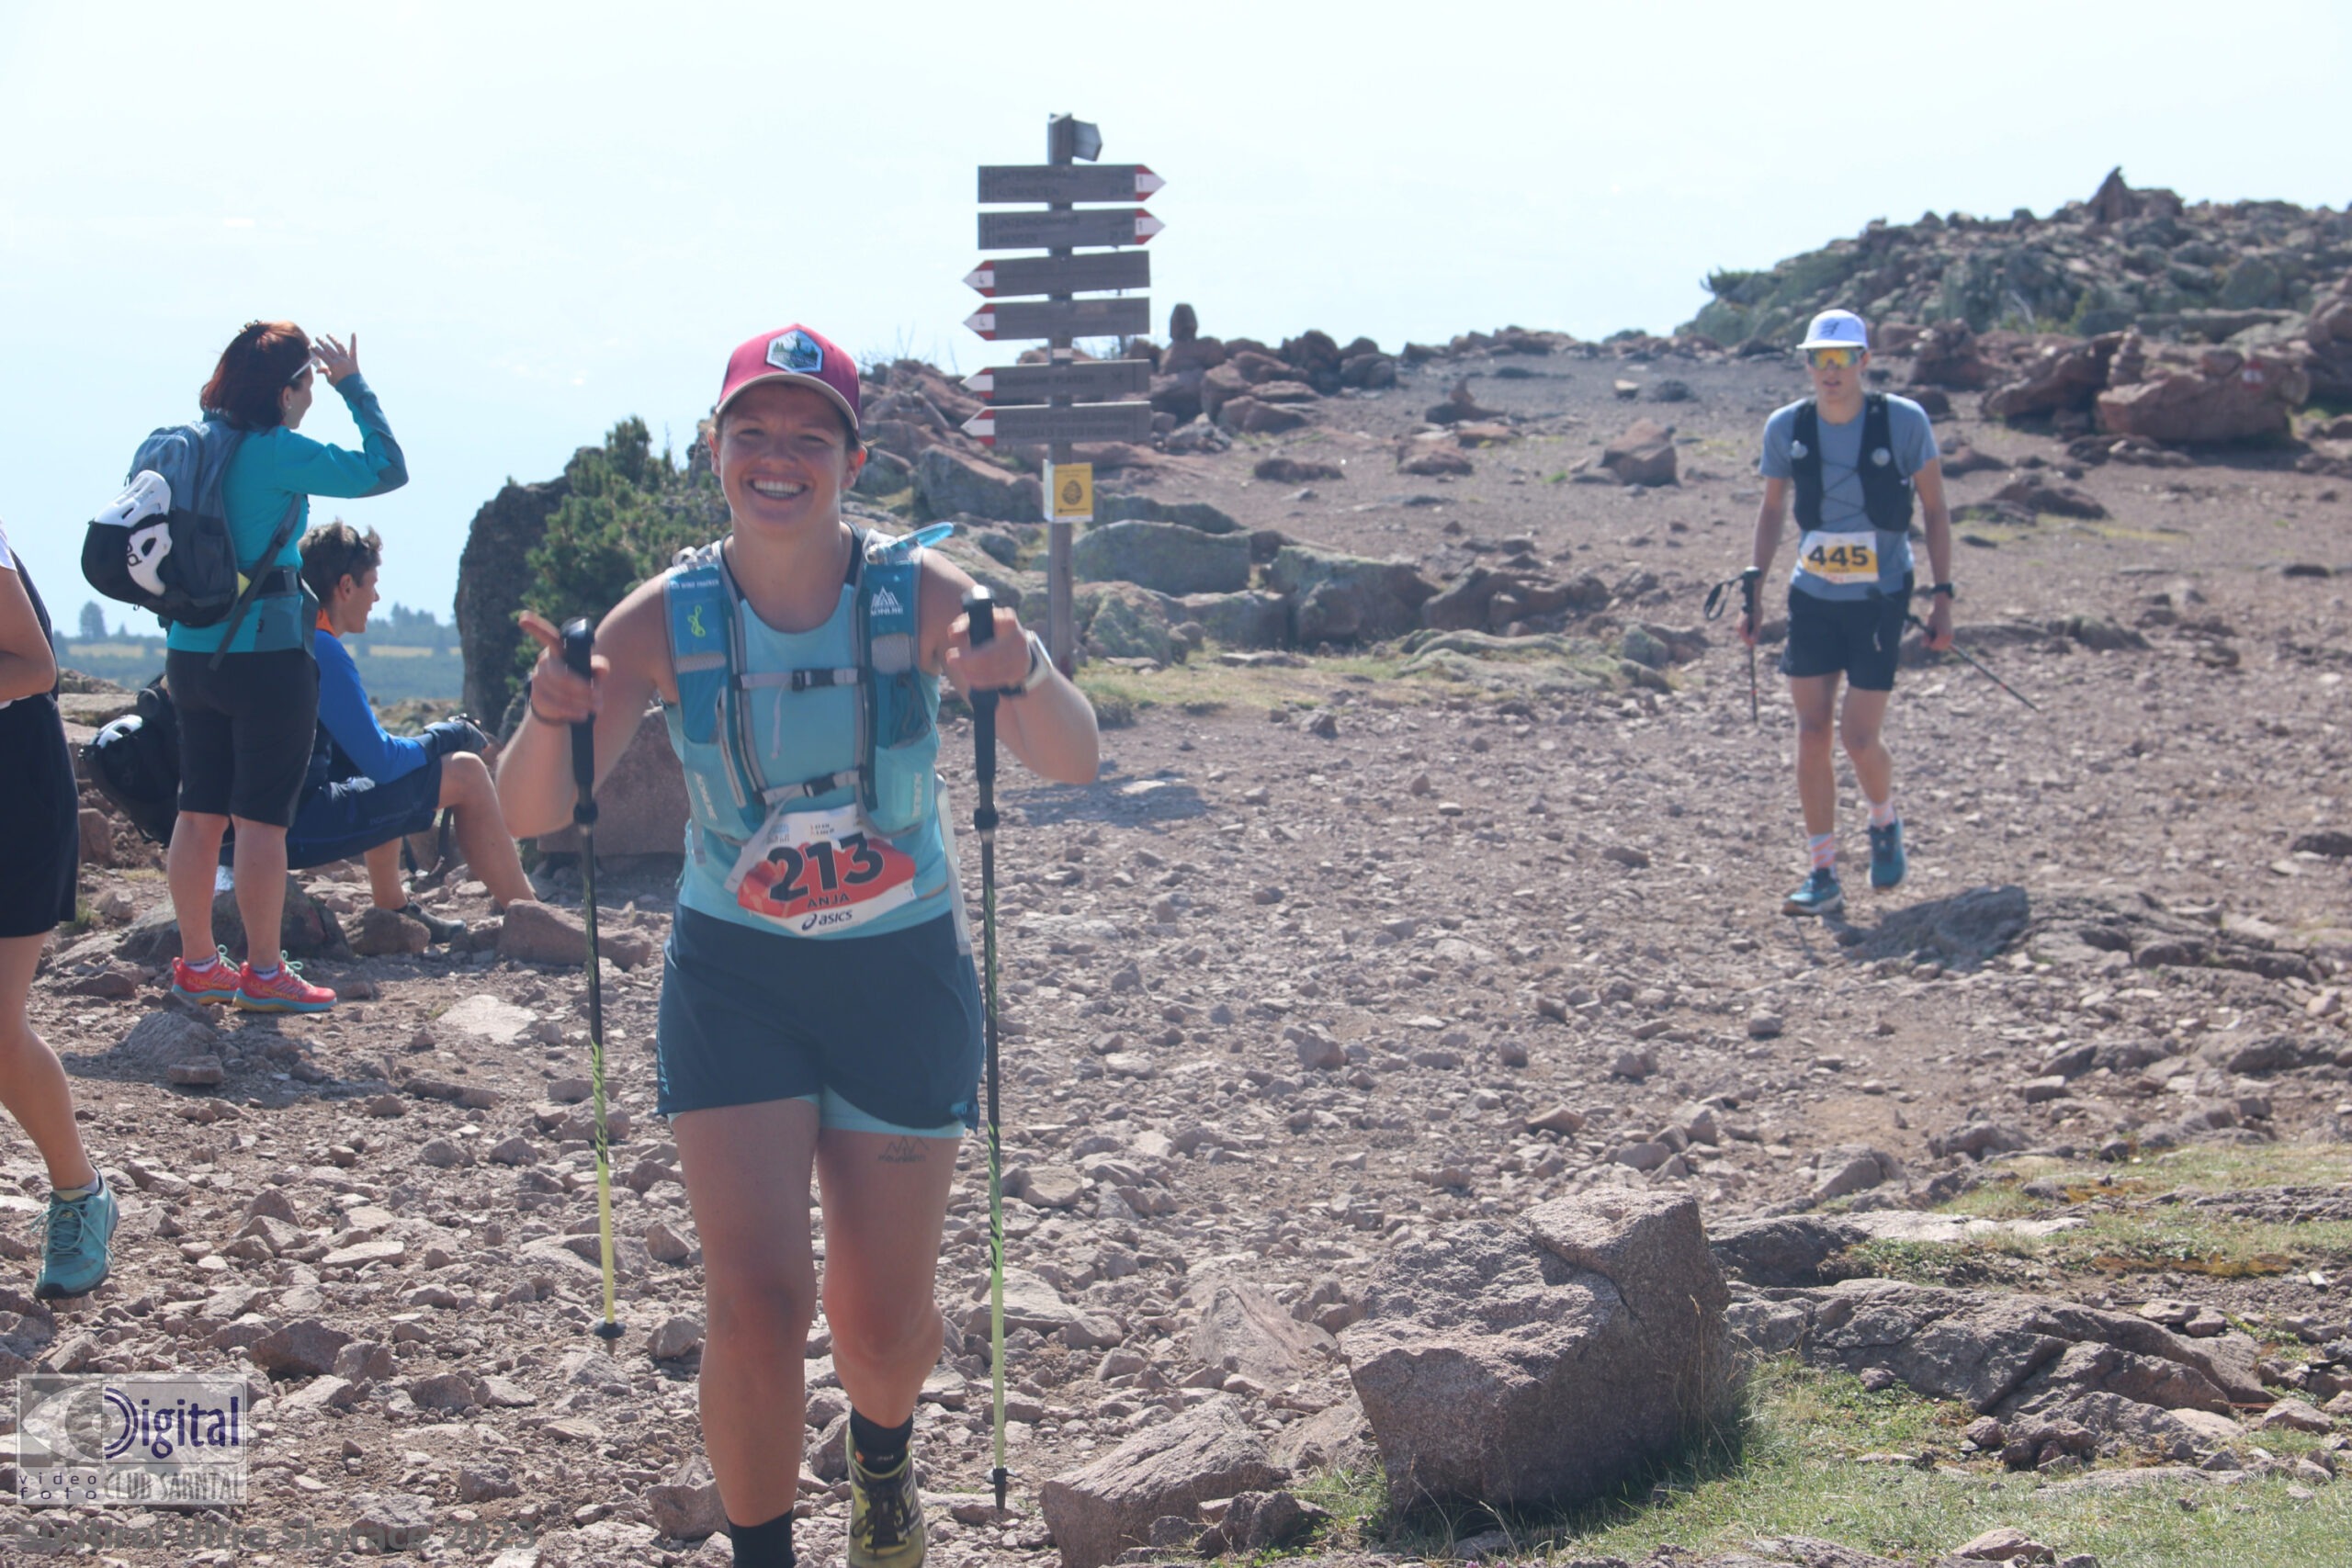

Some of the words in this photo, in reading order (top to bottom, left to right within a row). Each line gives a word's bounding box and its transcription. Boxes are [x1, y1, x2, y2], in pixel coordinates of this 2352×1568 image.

[1807, 545, 1869, 567] 445
[767, 832, 884, 902] 213
[807, 892, 850, 909] ANJA
